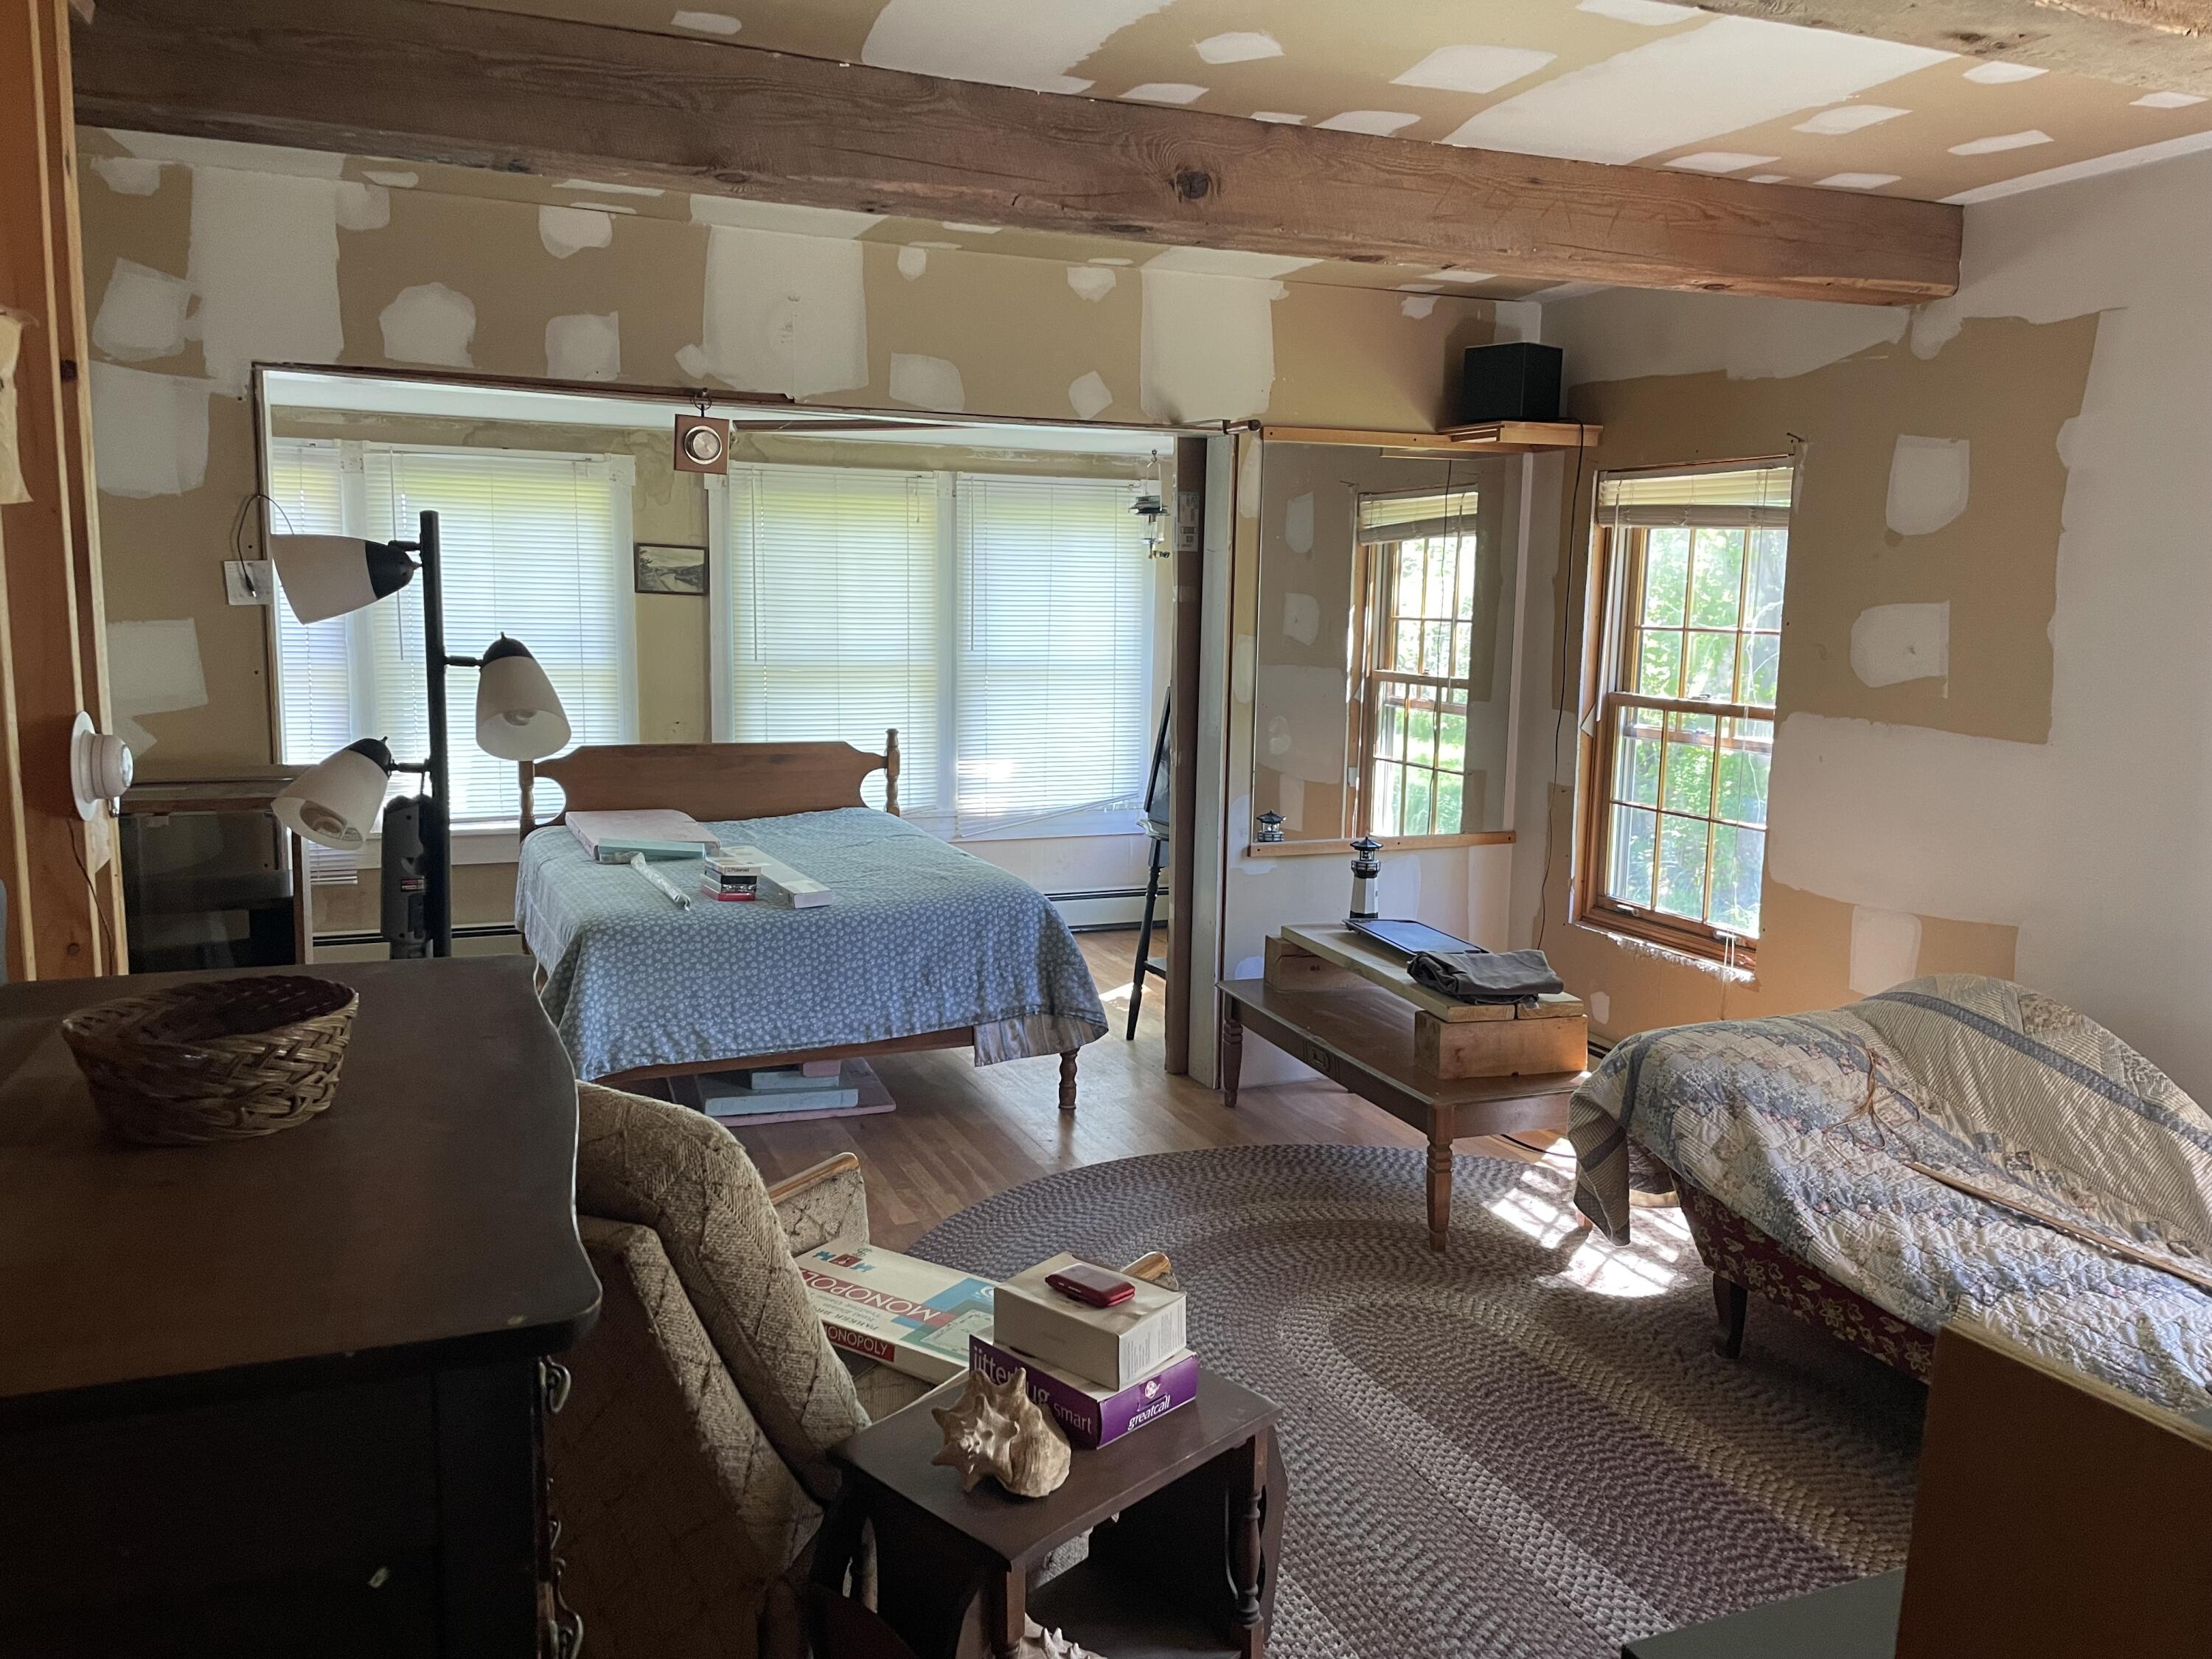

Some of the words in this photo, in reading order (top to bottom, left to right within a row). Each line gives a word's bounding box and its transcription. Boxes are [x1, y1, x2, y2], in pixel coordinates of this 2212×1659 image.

[803, 1270, 942, 1321] MONOPOL
[825, 1325, 888, 1357] ONOPOLY
[1054, 1402, 1092, 1435] smart
[1127, 1394, 1171, 1431] greatcall
